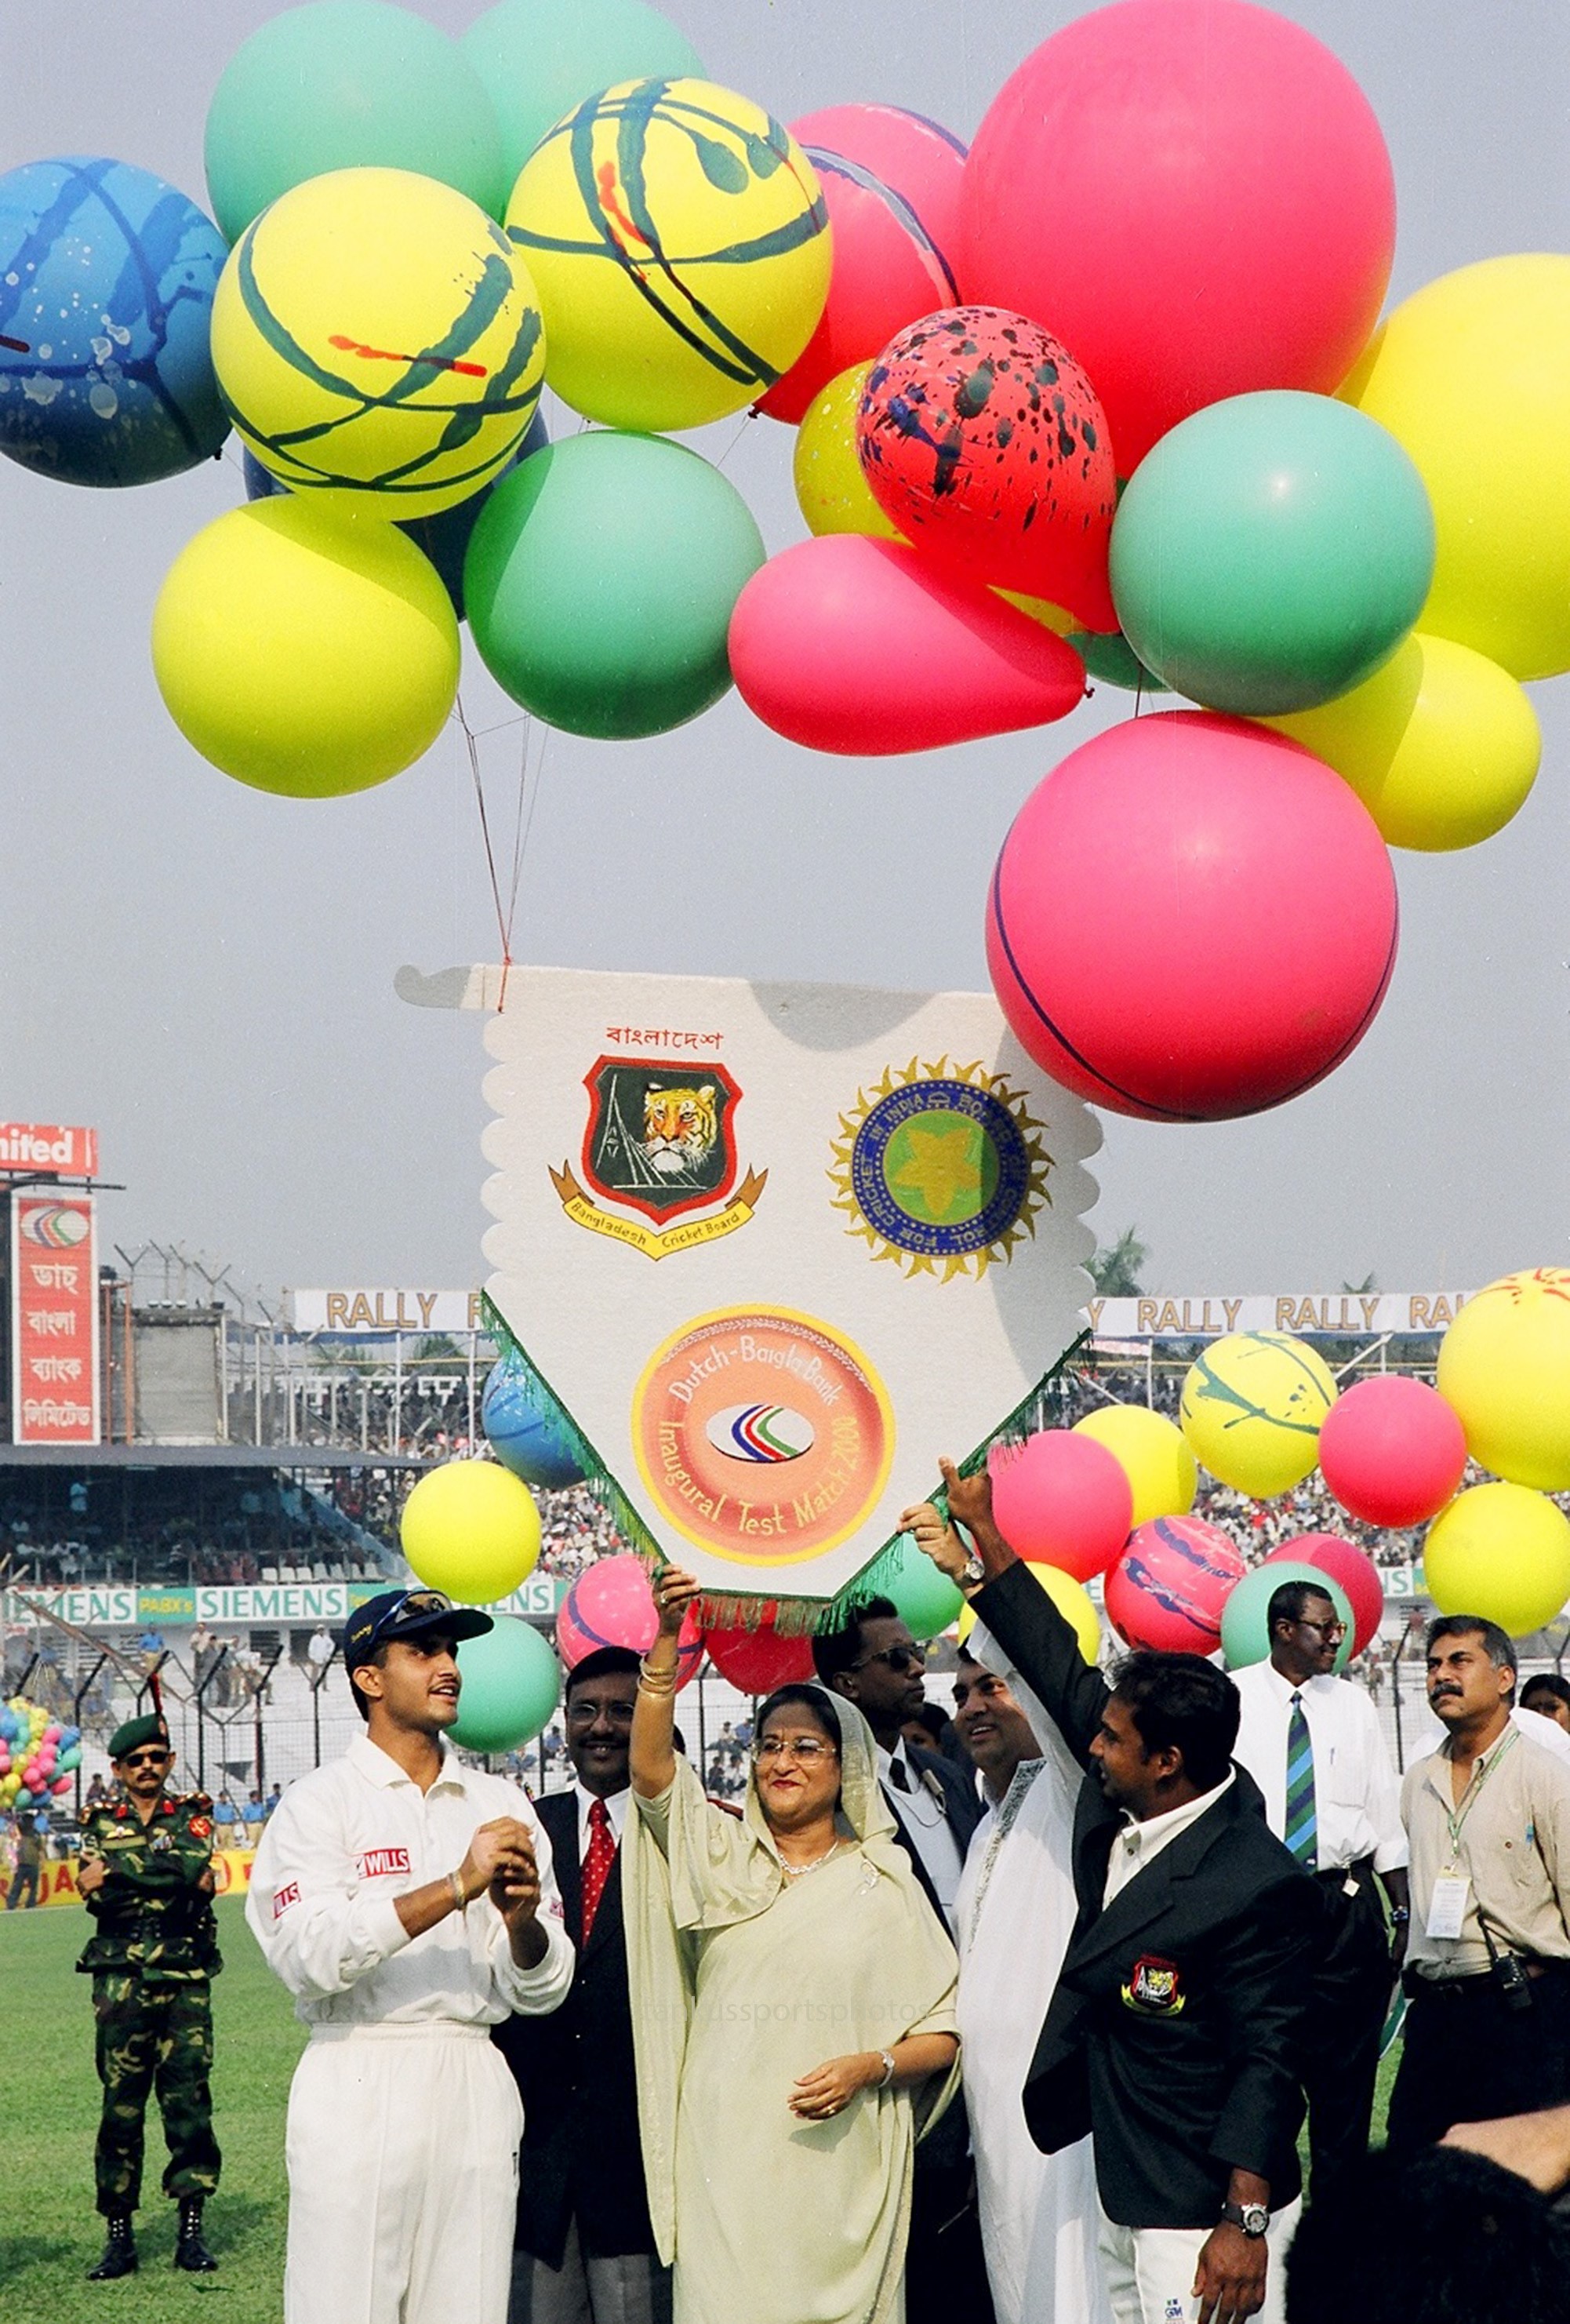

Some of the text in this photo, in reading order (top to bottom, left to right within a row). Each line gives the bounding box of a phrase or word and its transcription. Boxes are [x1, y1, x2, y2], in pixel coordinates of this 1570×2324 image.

[606, 1027, 724, 1050] বাংলাদেশ
[884, 1093, 925, 1122] INDIA
[869, 1126, 885, 1140] IN
[861, 1156, 896, 1227] CRICKET
[571, 1202, 740, 1248] Bangladesh Cricket Board
[26, 1308, 76, 1337] বাংলা
[326, 1293, 438, 1329] RALLY
[1137, 1299, 1243, 1333] RALLY
[1275, 1297, 1380, 1331] RALLY
[30, 1355, 82, 1384] ব্যাংক
[658, 1420, 728, 1523] Inaugural
[738, 1500, 787, 1536] Test
[791, 1468, 849, 1529] Match
[201, 1588, 342, 1618] SIEMENS
[365, 1851, 409, 1876] WILLS
